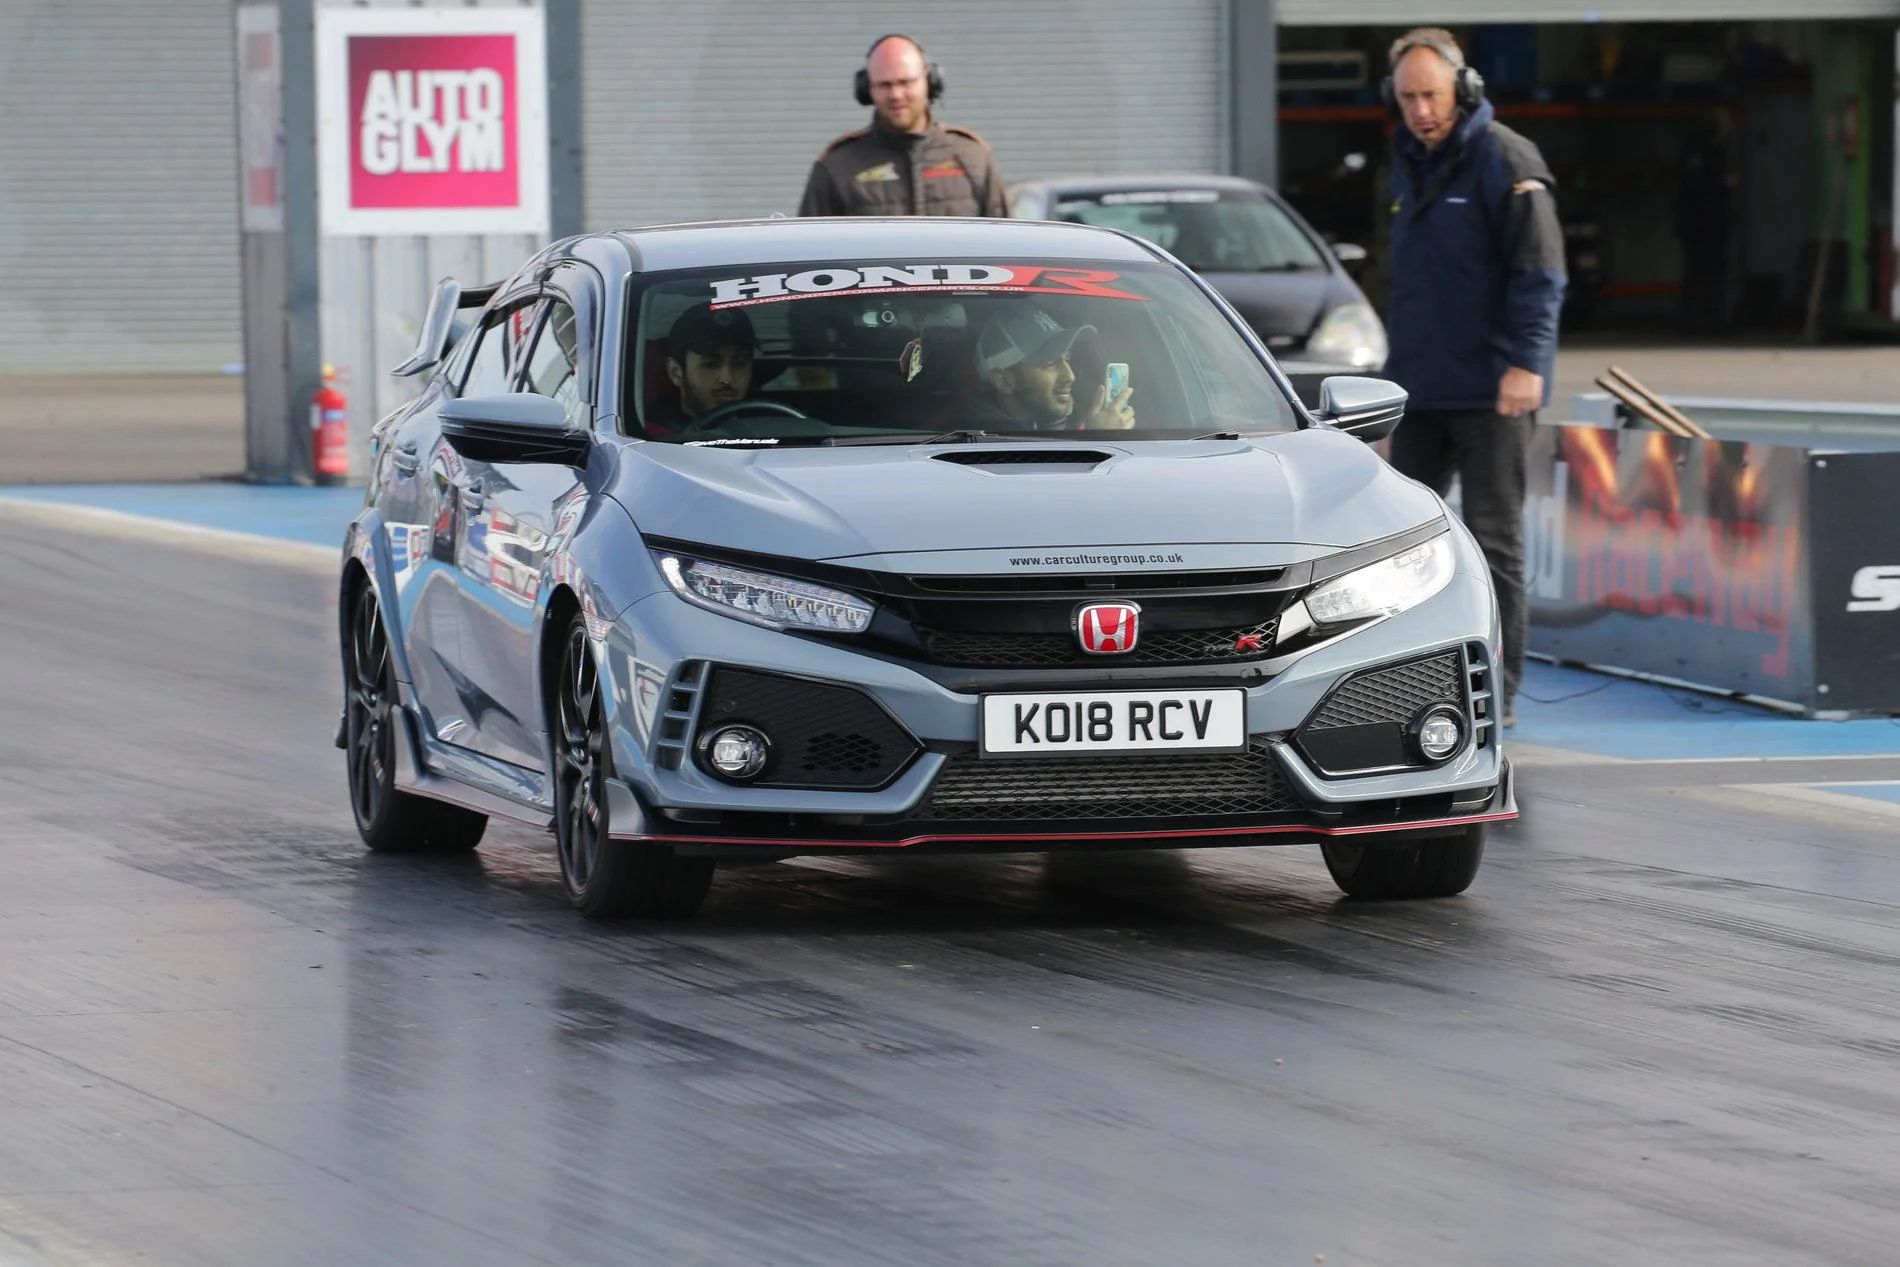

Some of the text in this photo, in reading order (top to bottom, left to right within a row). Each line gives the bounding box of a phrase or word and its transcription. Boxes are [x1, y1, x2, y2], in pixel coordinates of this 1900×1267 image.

[361, 68, 504, 122] AUTO
[360, 119, 505, 175] GLYM
[1009, 552, 1184, 566] www.carculturegroup.co.uk
[1014, 699, 1213, 744] KO18 RCV
